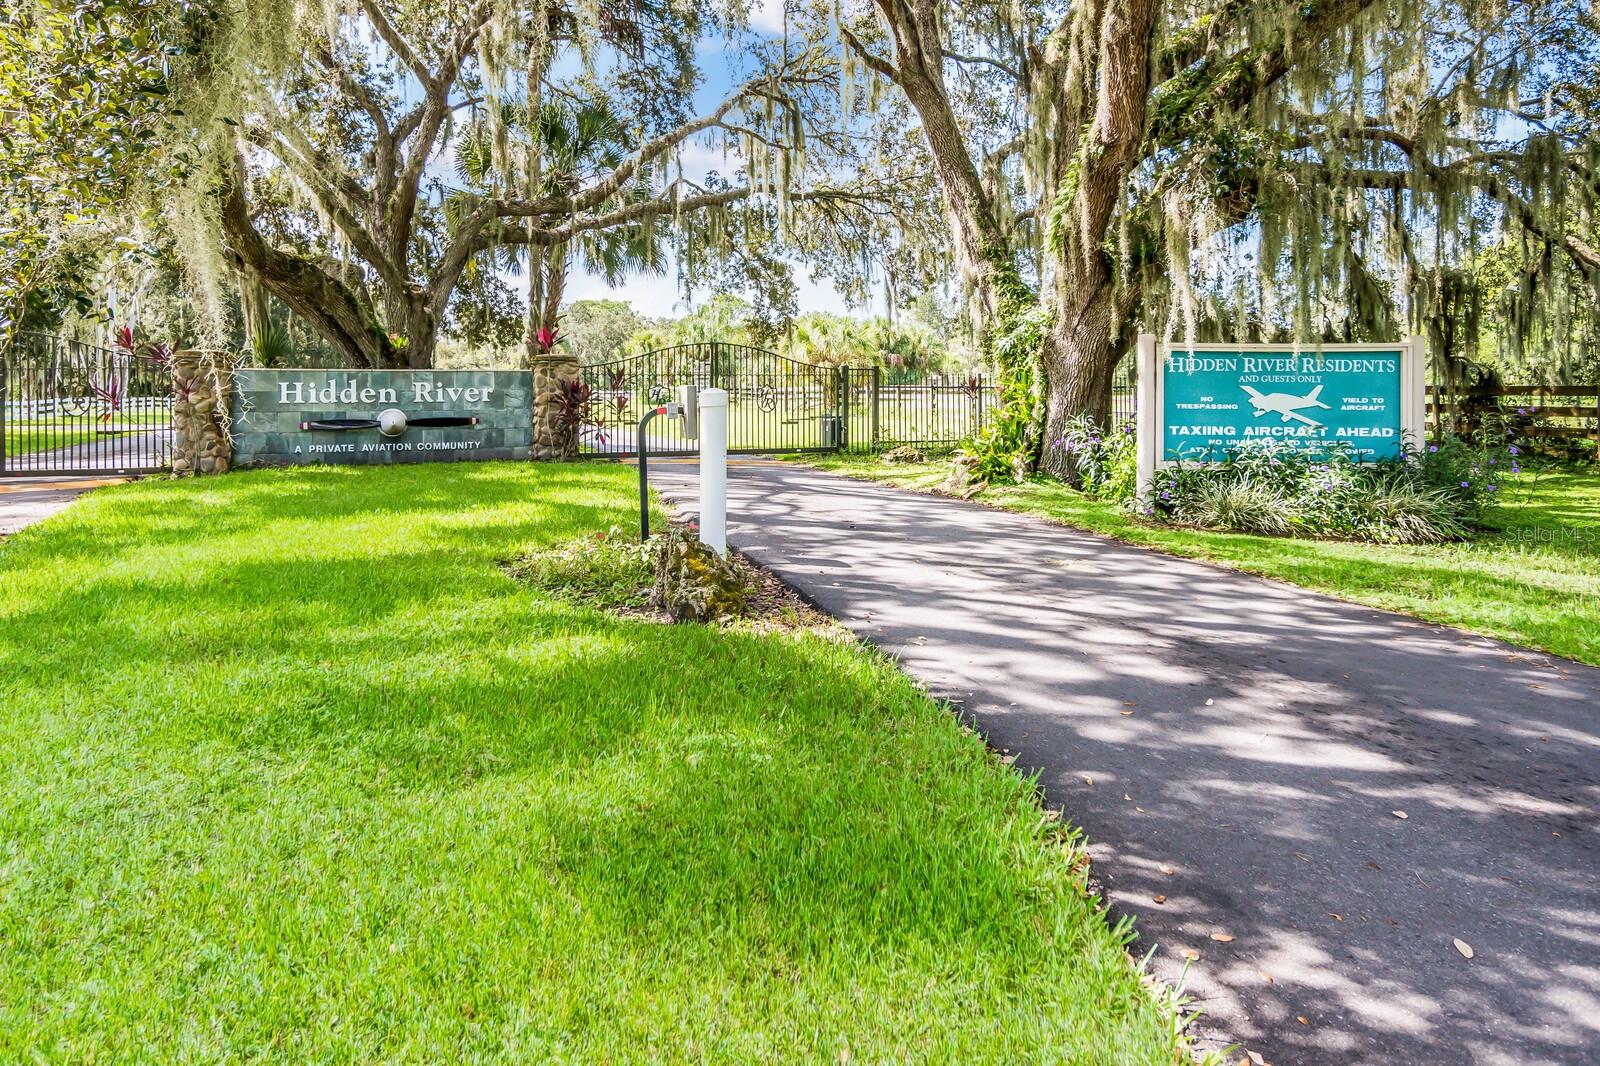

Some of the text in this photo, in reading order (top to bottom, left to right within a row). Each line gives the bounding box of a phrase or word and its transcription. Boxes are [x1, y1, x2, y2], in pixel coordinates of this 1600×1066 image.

[1168, 357, 1396, 374] HIDDEN RIVER RESIDENTS
[1238, 374, 1322, 383] AND GUESTS ONLY
[278, 379, 495, 404] Hidden River
[1168, 425, 1394, 438] TAXIING AIRCRAFT AHEAD
[294, 441, 481, 453] A PRIVATE AVIATION COMMUNITY
